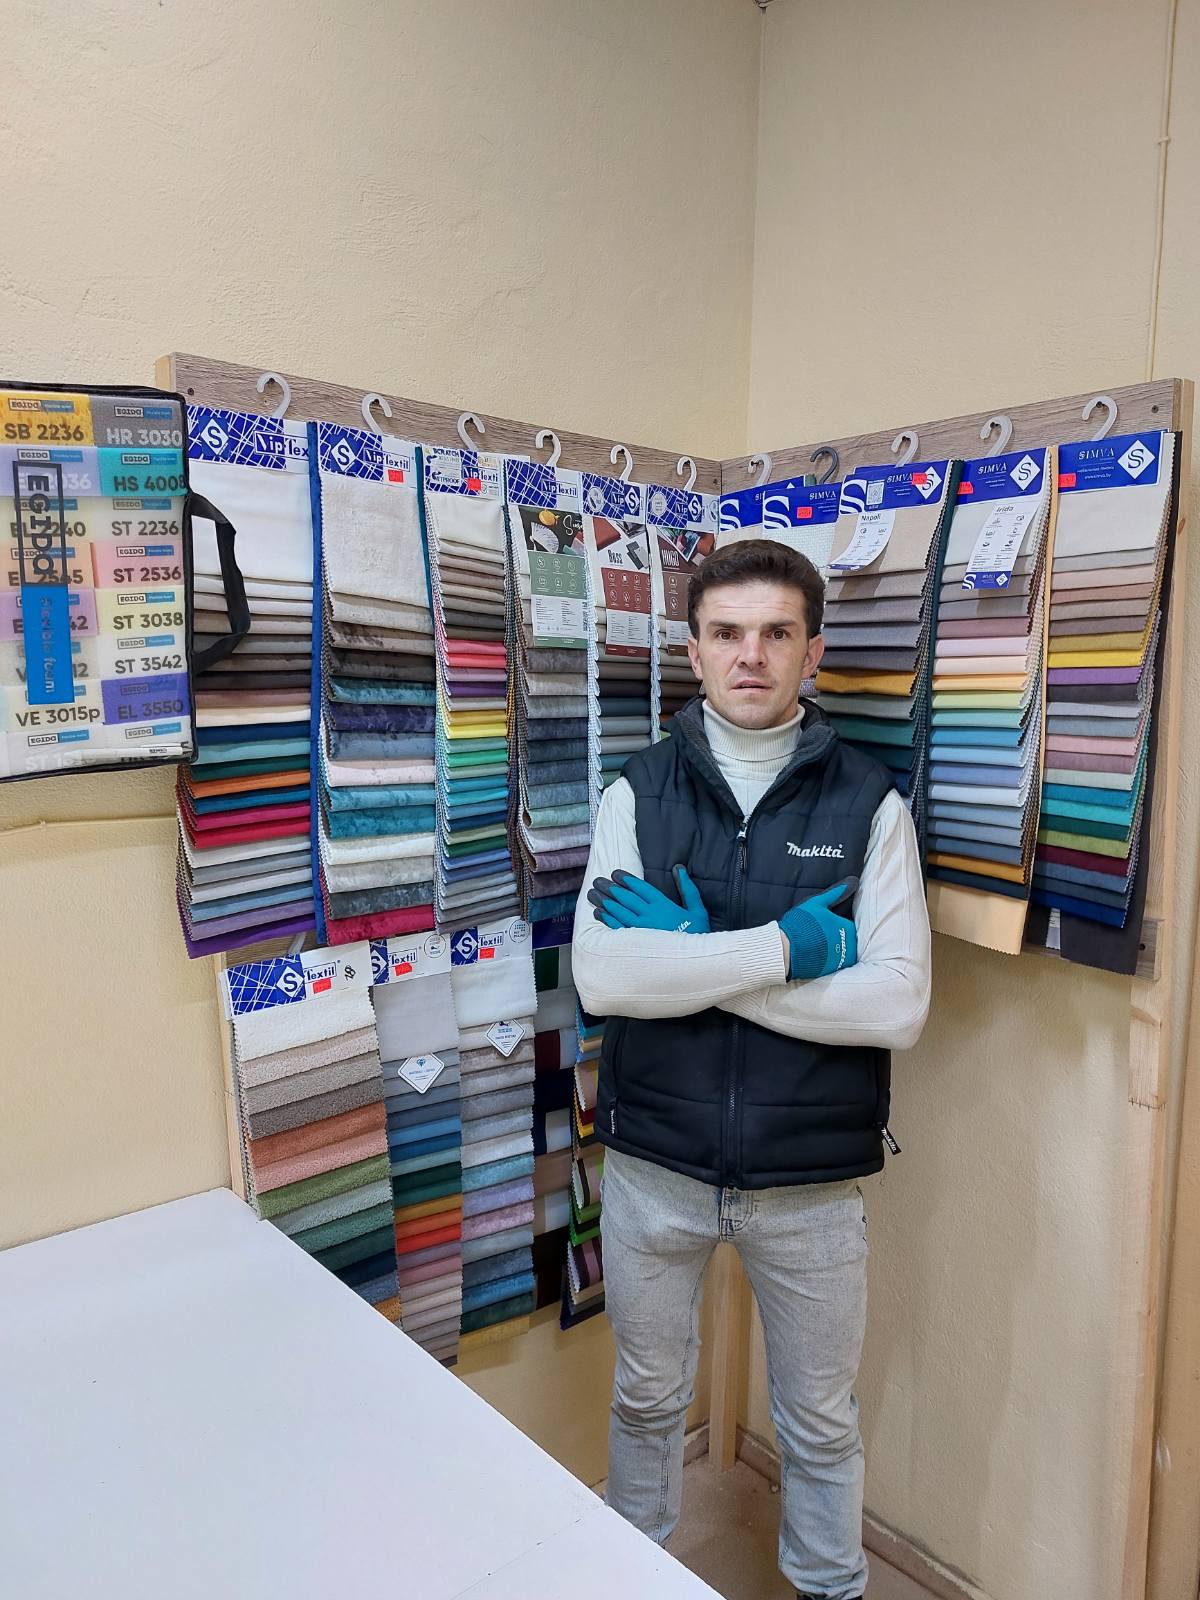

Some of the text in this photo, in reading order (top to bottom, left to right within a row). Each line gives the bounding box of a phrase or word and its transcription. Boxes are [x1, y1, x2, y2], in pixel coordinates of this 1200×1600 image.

[4, 423, 84, 441] SB 2236
[106, 428, 183, 446] HR 3030
[1078, 447, 1114, 460] SIMVA
[977, 462, 1007, 475] SIMVA
[113, 475, 187, 492] HS 4008
[886, 473, 913, 484] SIMVA
[809, 490, 836, 500] SIMVA
[111, 520, 179, 536] ST 2236
[113, 566, 182, 583] ST 2536
[113, 612, 184, 630] ST 3038
[114, 654, 183, 674] ST 3542
[15, 705, 100, 727] VE 3015p
[118, 699, 184, 720] EL 3550
[479, 935, 503, 947] Textil
[389, 951, 416, 965] Textil
[304, 966, 335, 981] Textil
